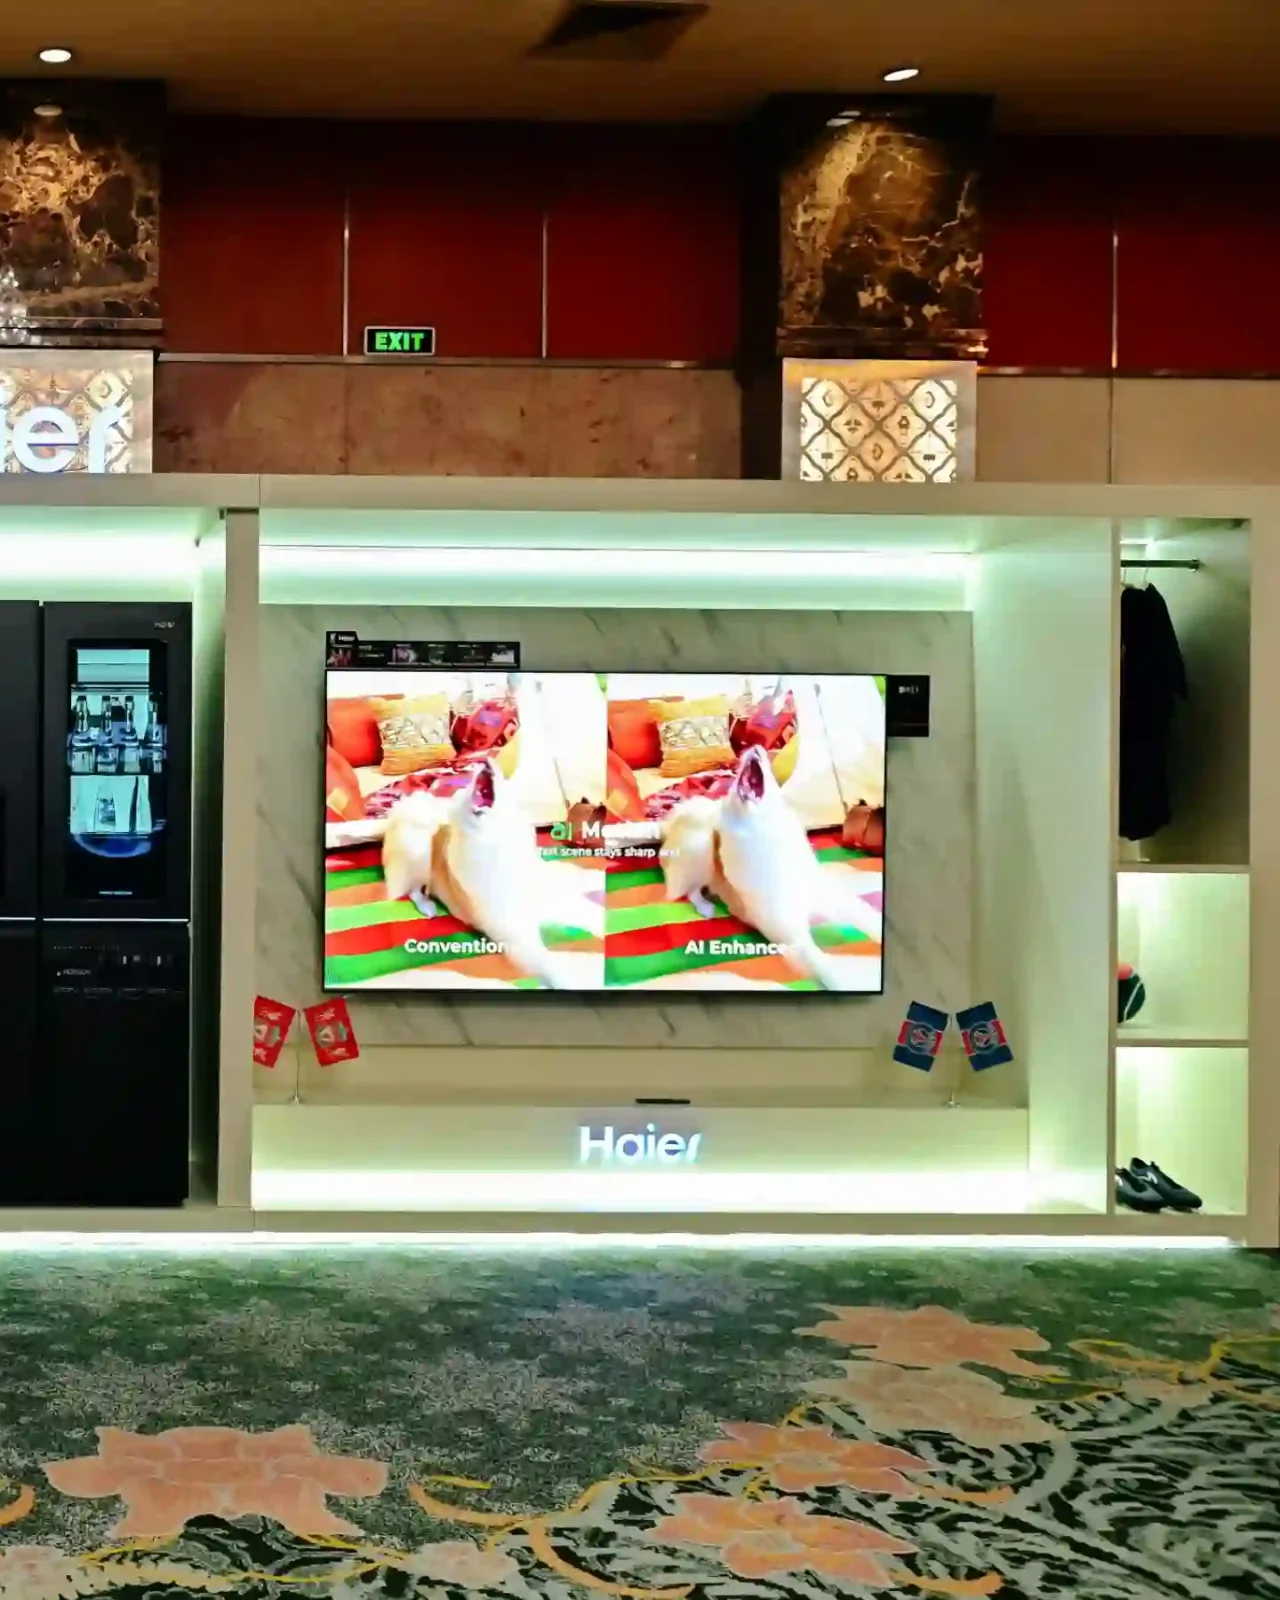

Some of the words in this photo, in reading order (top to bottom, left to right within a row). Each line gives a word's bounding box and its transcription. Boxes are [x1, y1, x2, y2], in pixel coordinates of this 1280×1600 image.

[375, 332, 425, 351] EXIT
[561, 848, 592, 857] scene
[594, 847, 621, 859] stays
[624, 846, 656, 859] sharp
[684, 940, 705, 955] AI
[579, 1123, 703, 1164] Haier
